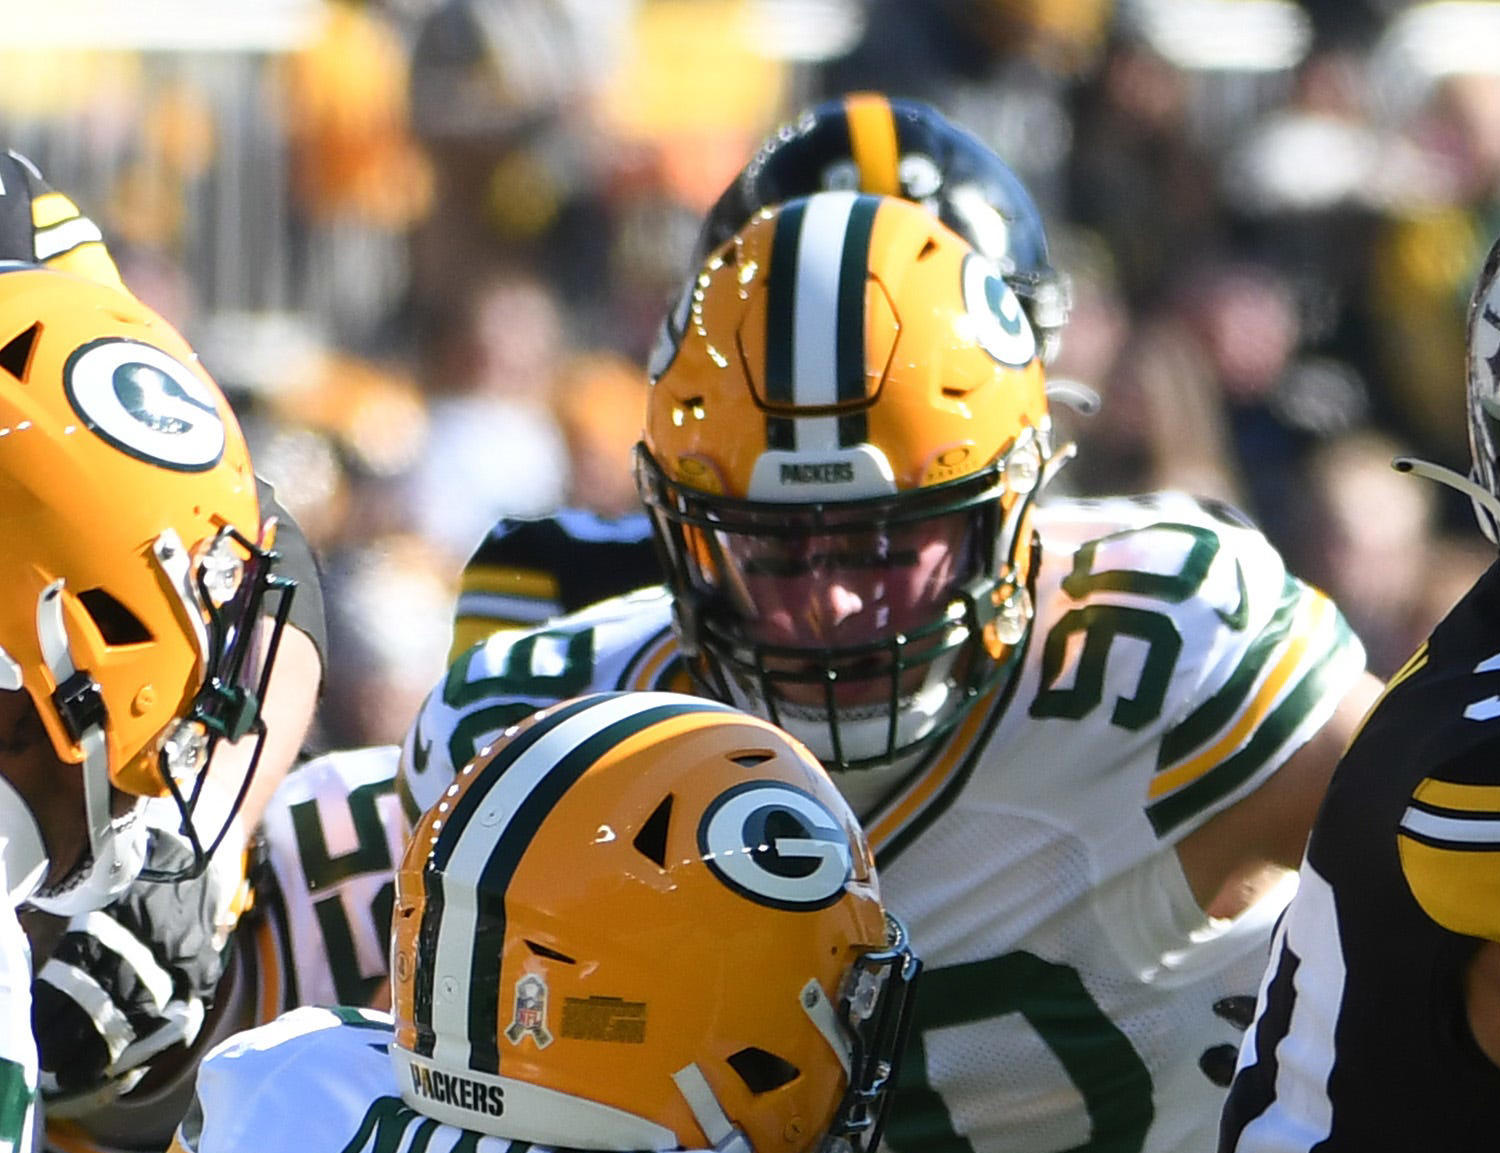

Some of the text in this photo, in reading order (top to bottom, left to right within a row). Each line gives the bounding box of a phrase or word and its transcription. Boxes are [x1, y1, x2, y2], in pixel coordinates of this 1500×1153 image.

[66, 338, 226, 474] G
[696, 779, 852, 913] G
[518, 1007, 542, 1028] NFL
[409, 1062, 505, 1117] PACKERS
